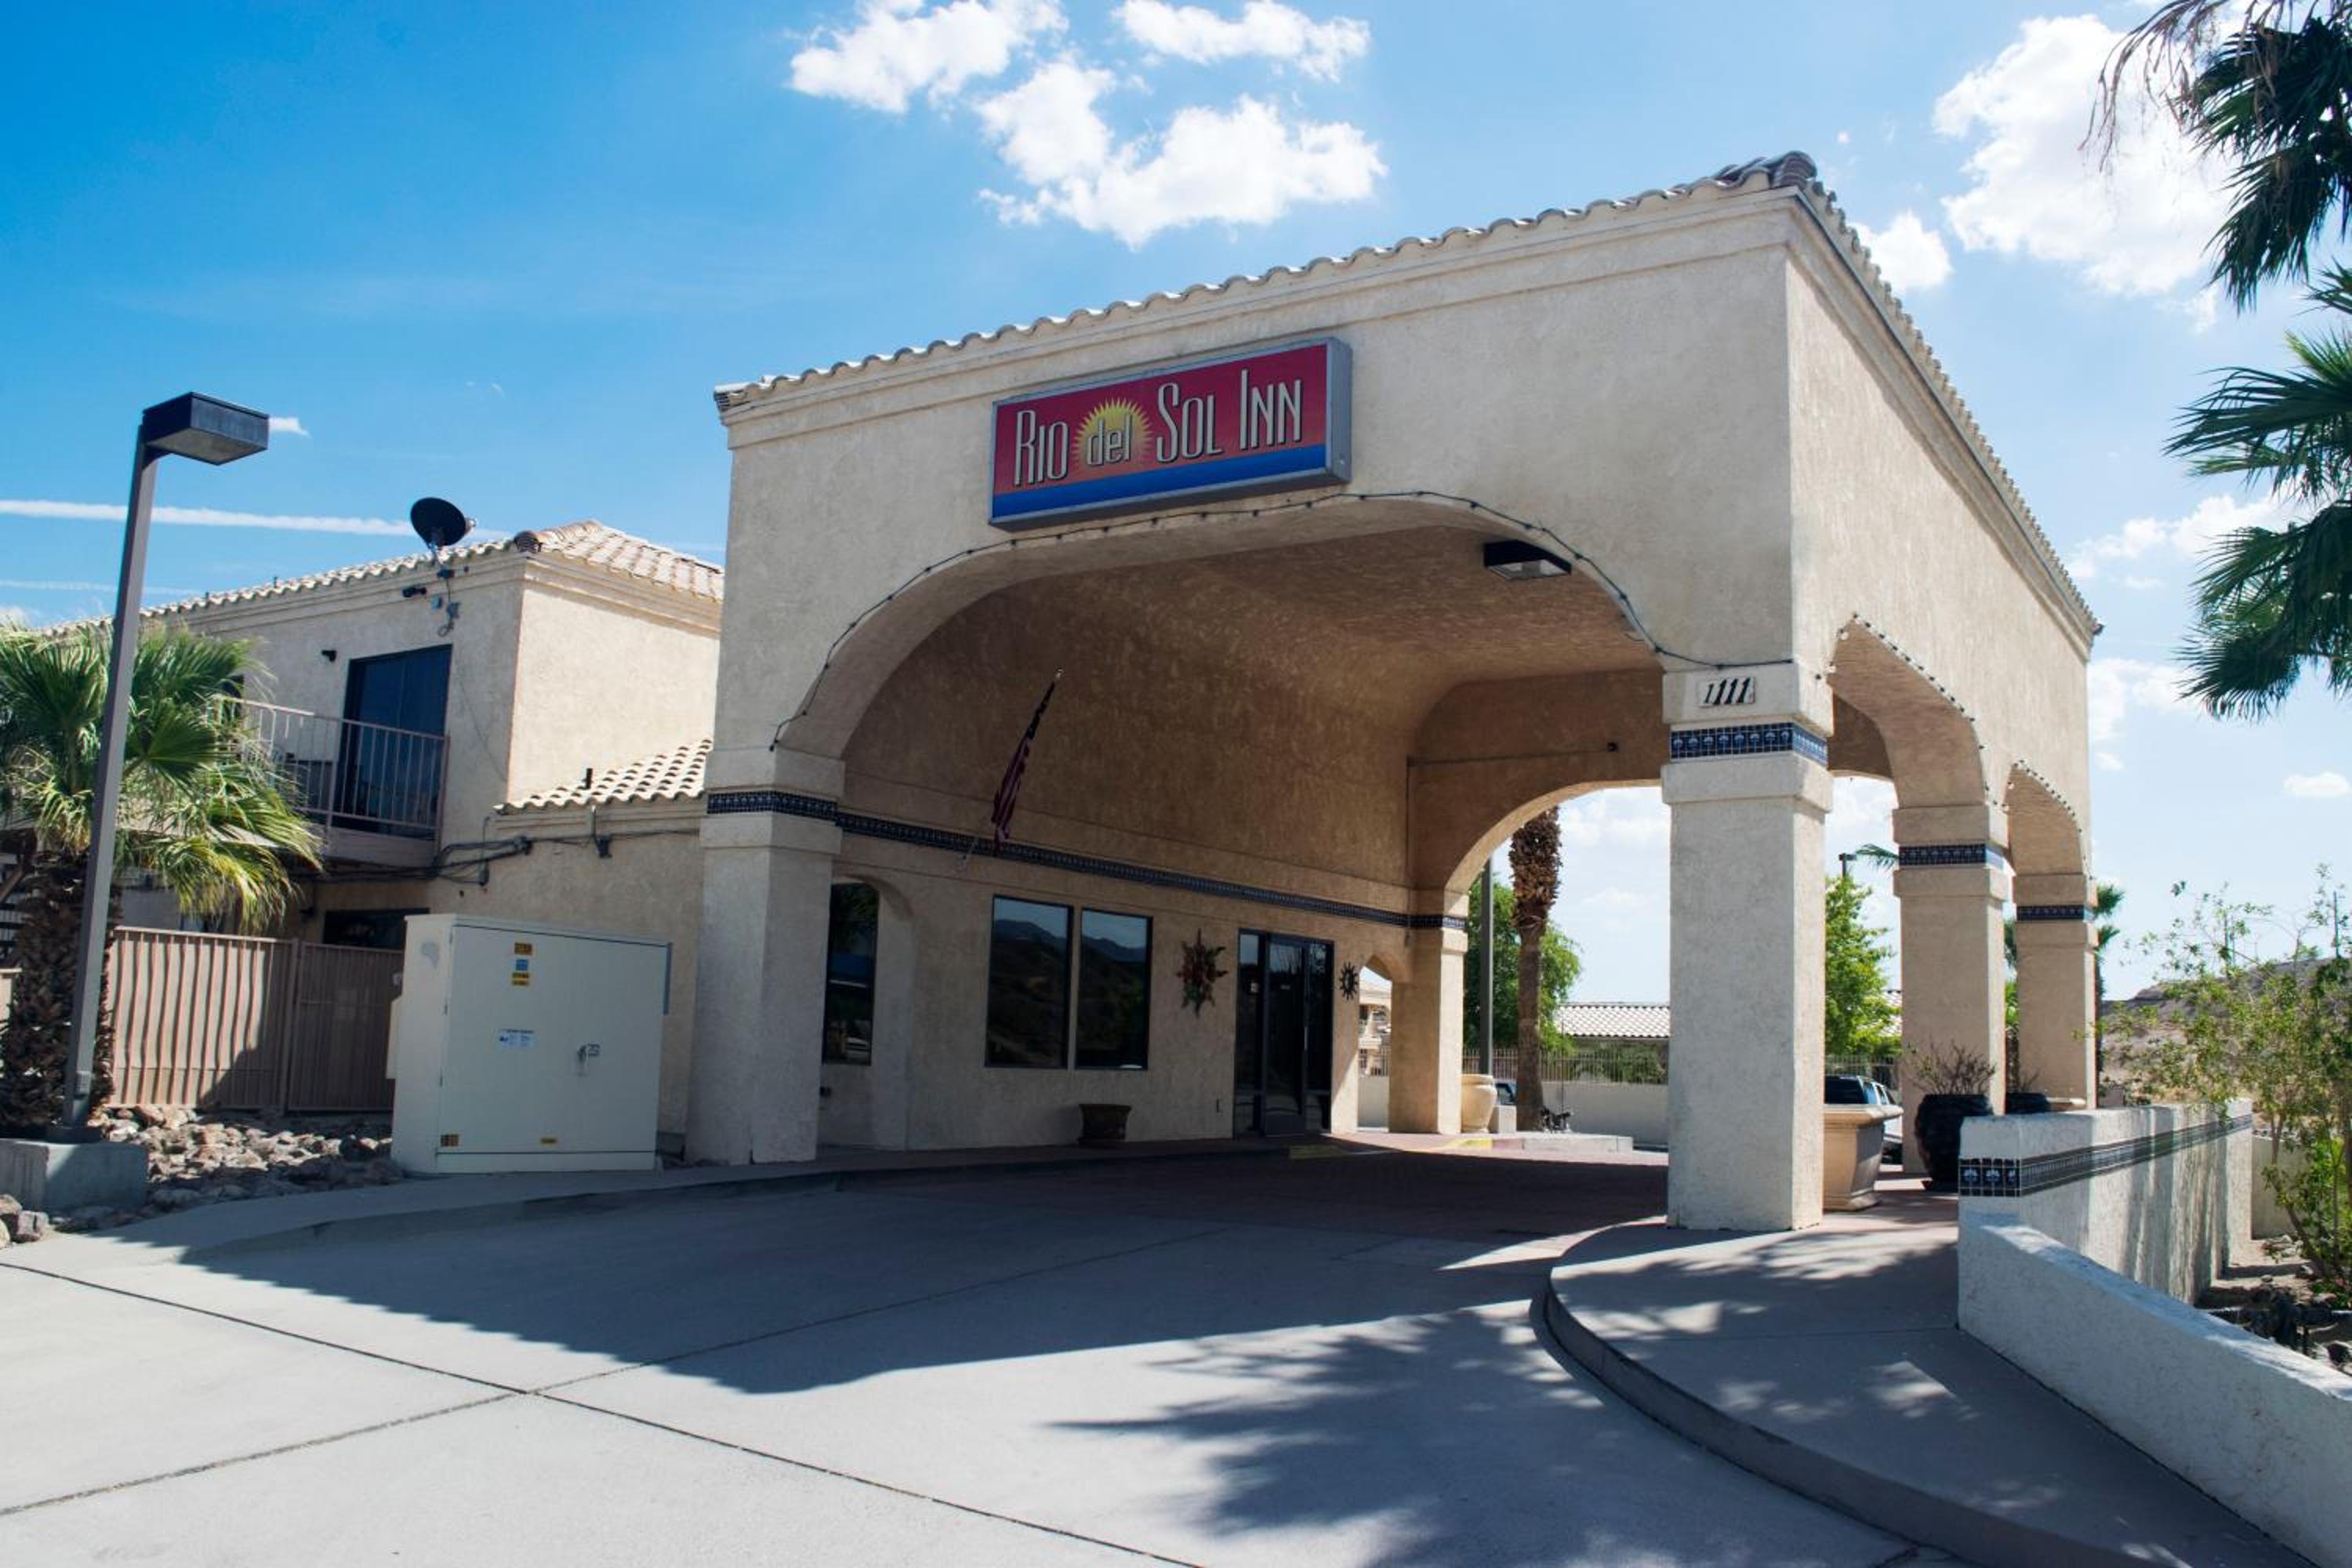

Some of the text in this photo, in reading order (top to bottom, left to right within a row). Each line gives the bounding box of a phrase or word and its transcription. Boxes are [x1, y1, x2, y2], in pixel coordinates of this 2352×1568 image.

[1086, 413, 1134, 467] del
[1239, 368, 1302, 451] INN
[1704, 677, 1751, 705] 1111
